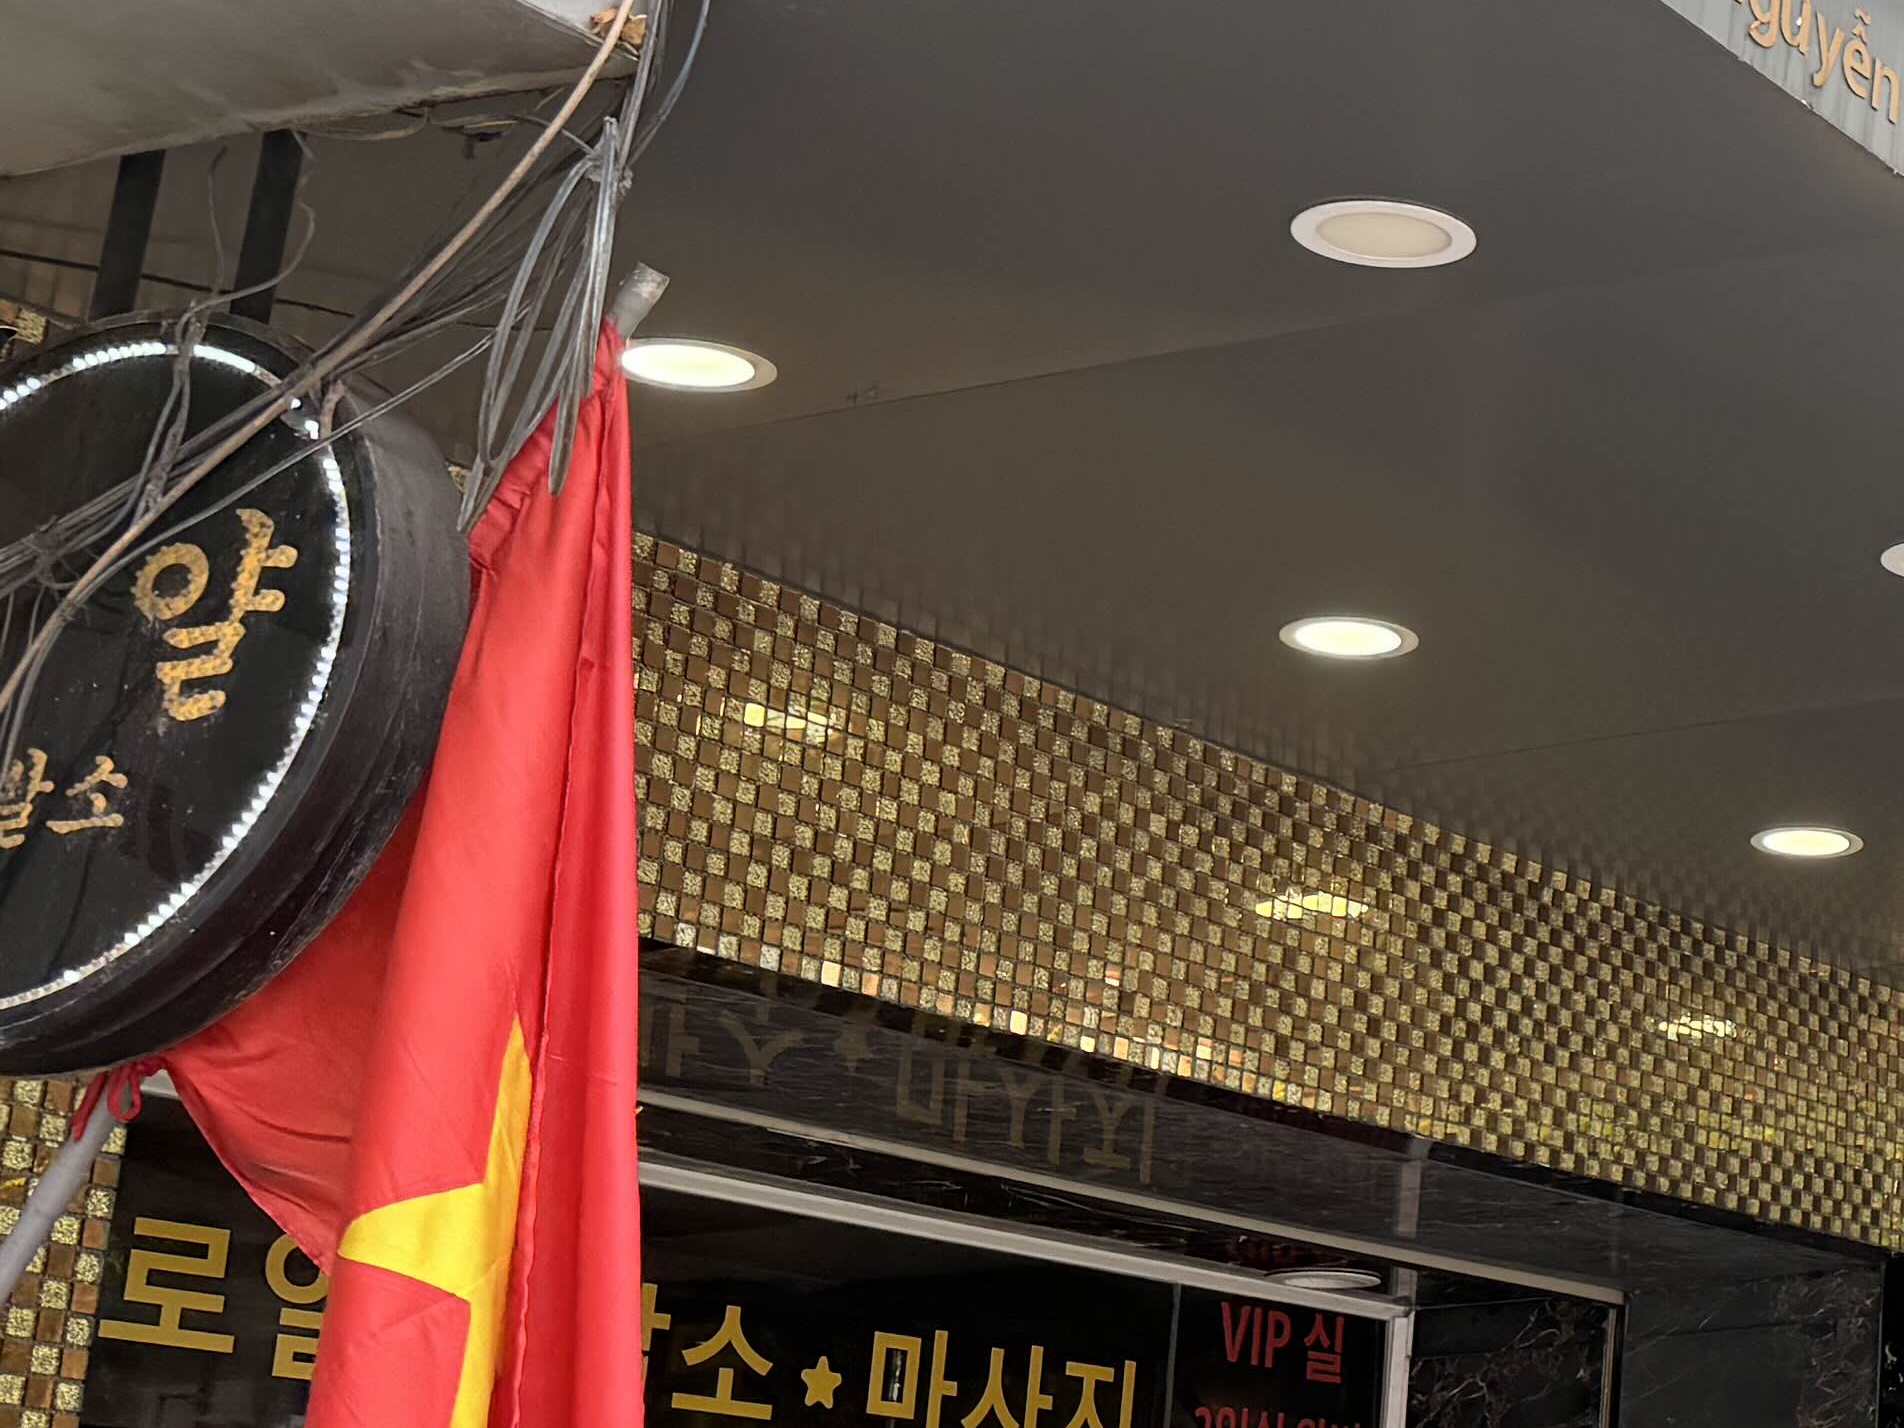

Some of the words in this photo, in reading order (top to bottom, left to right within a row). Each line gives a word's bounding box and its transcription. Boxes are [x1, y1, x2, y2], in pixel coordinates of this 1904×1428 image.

[133, 507, 299, 723] 얄
[1220, 1301, 1291, 1368] VIP
[1302, 1315, 1345, 1384] 실
